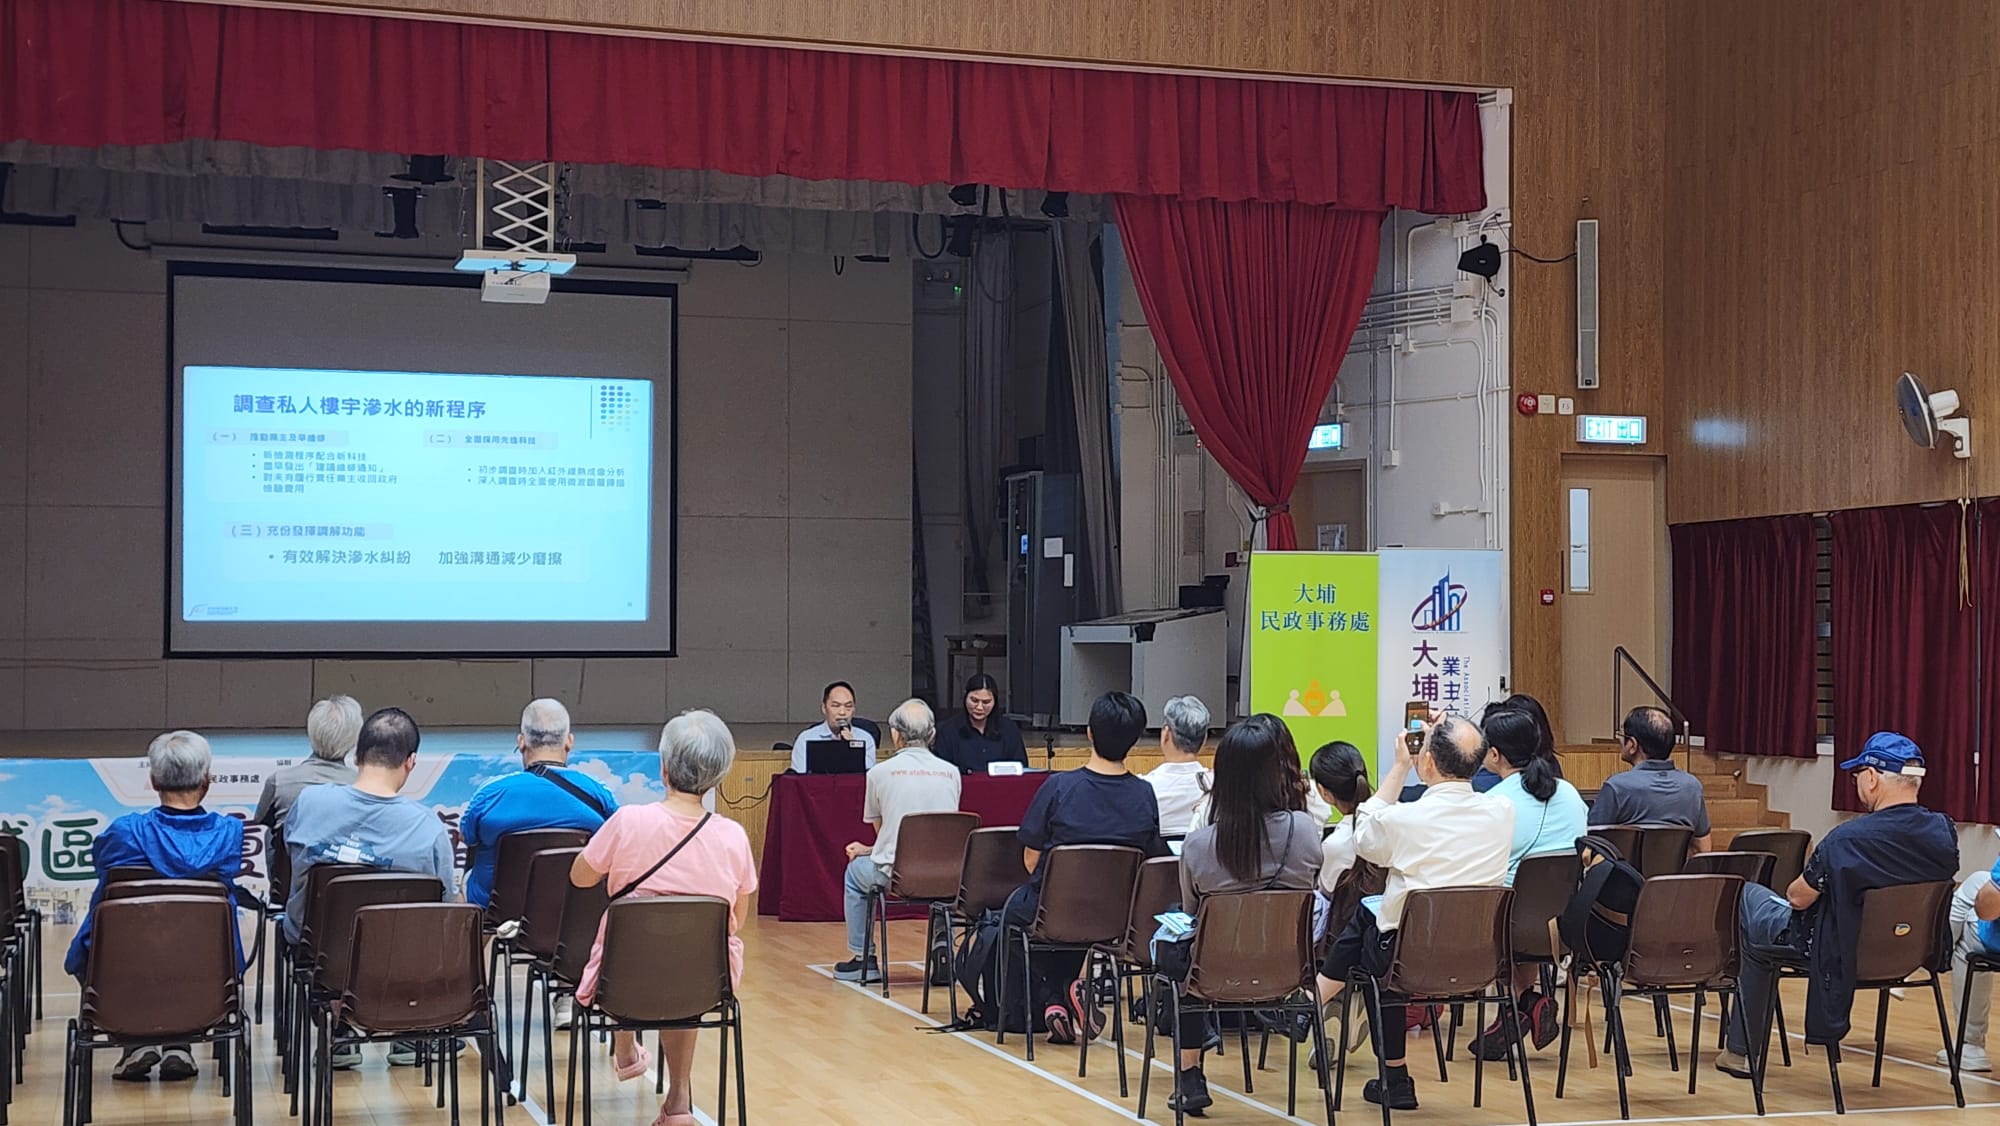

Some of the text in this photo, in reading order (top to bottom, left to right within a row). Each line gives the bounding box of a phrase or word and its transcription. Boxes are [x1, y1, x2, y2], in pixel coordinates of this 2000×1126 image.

[233, 394, 486, 419] 調查私人樓宇滲水的新程序
[1587, 419, 1641, 439] EXIT 出口
[282, 548, 563, 566] 有效解決滲水糾紛 加強溝通減少磨擦
[1294, 583, 1337, 605] 大埔
[1260, 610, 1371, 632] 民政事務處
